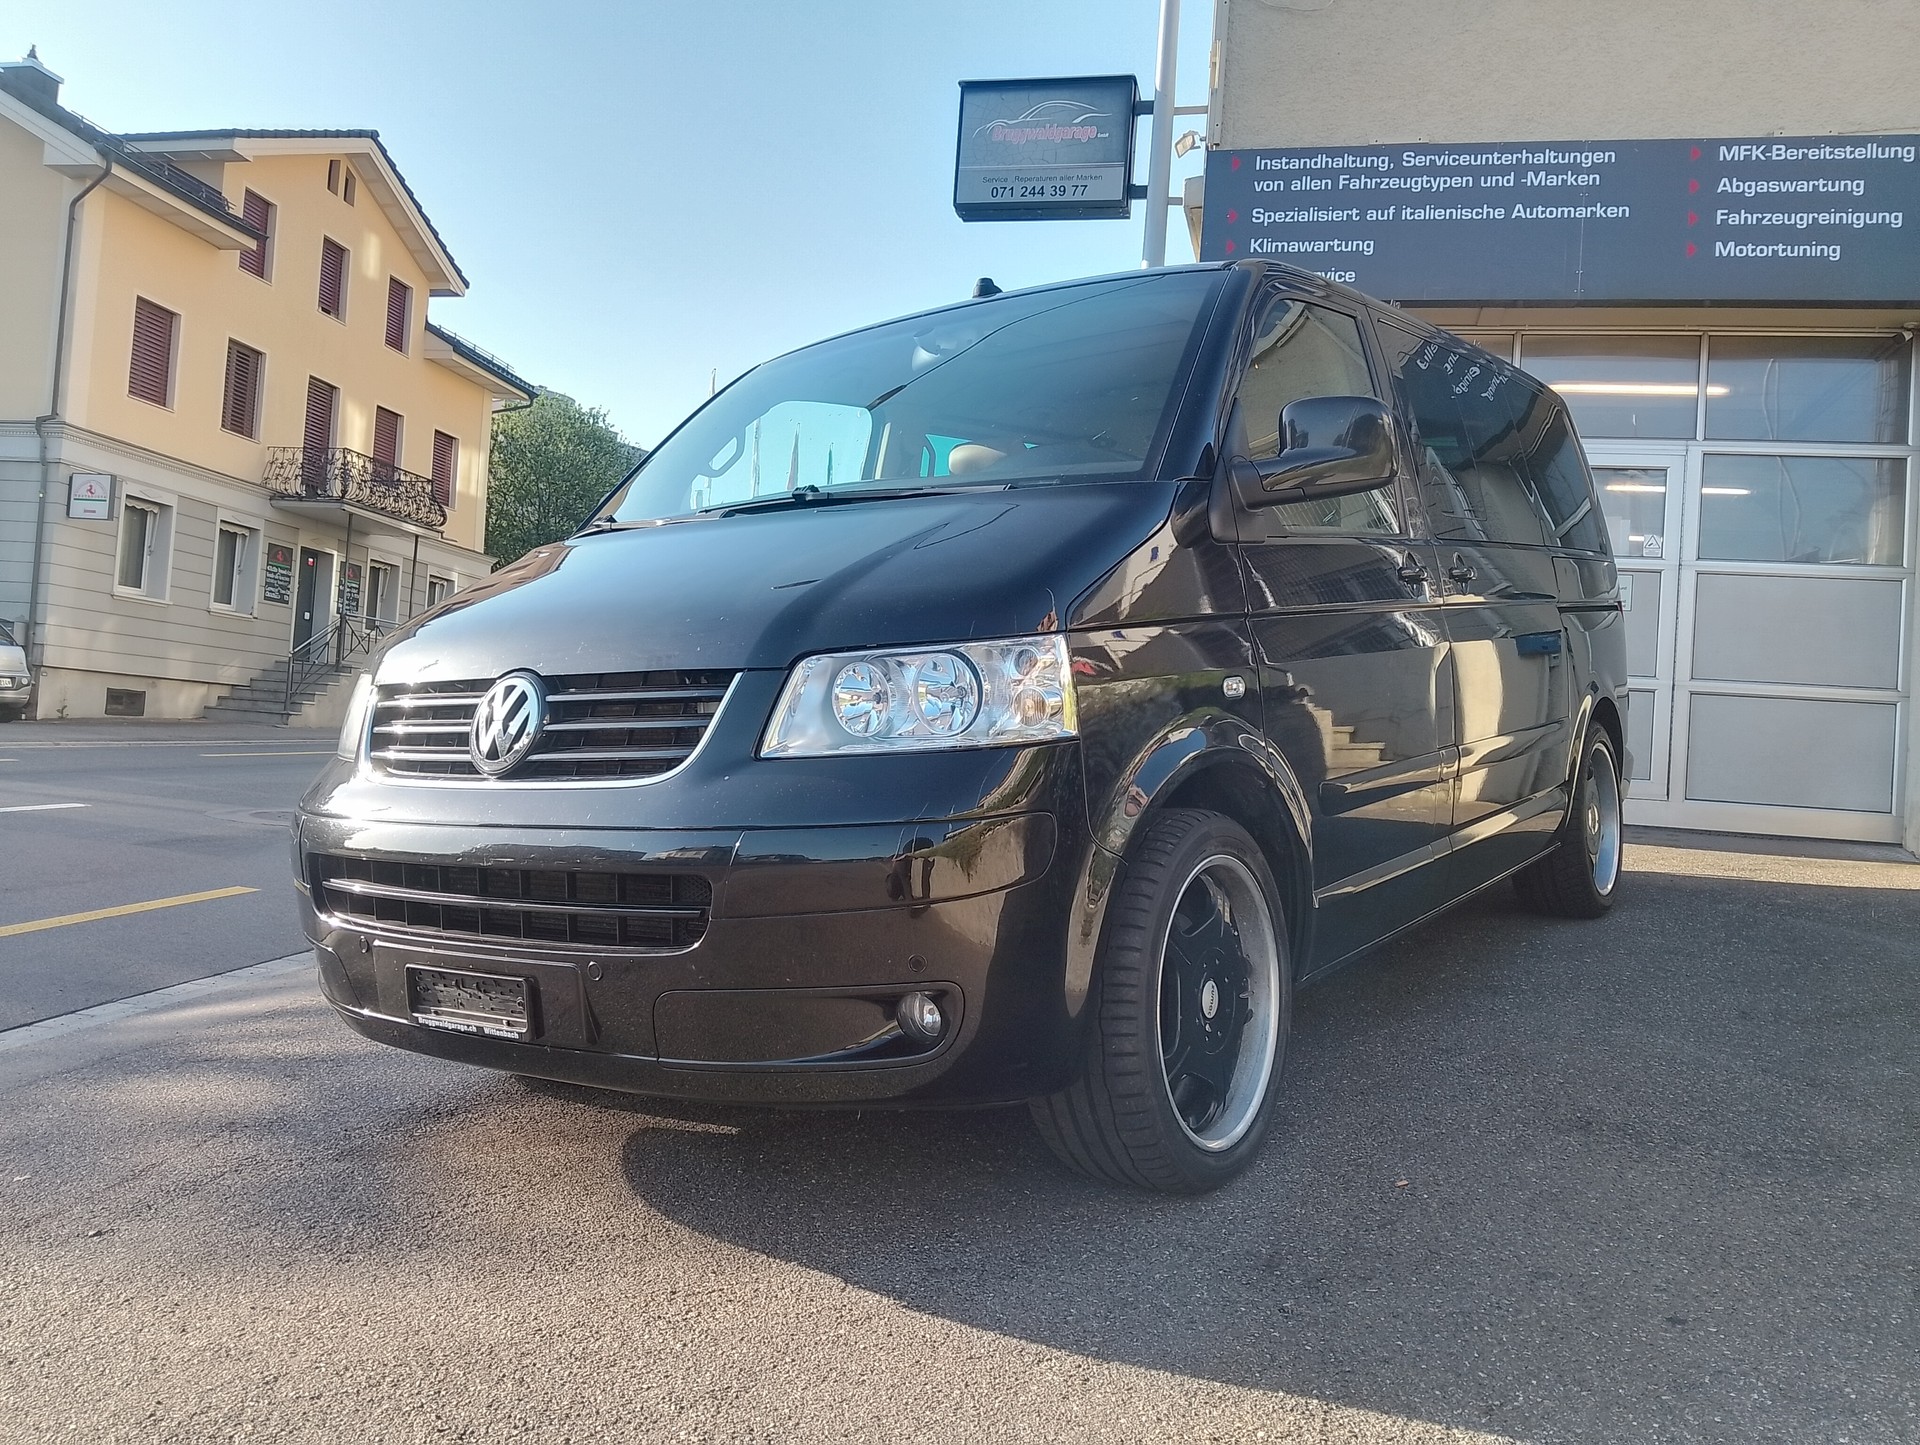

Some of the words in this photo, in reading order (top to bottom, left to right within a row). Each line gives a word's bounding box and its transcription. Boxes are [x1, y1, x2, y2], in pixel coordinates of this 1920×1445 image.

[992, 123, 1097, 144] Bruggwaldgarage
[1255, 153, 1394, 171] Instandhaltung,
[1402, 149, 1616, 167] Serviceunterhaltungen
[1718, 143, 1915, 162] MFK-Bereitstellung
[982, 176, 1009, 184] Service
[1059, 174, 1075, 182] aller
[1254, 180, 1284, 192] von
[1290, 176, 1332, 191] allen
[1338, 174, 1473, 192] Fahrzeugtypen
[1480, 171, 1515, 187] und
[1521, 170, 1600, 187] -Marken
[1716, 177, 1865, 197] Abgaswartung
[990, 186, 1014, 199] 071
[1020, 185, 1046, 198] 244
[1050, 184, 1067, 197] 39
[1071, 184, 1088, 197] 77
[1251, 207, 1360, 226] Spezialisiert
[1366, 205, 1396, 221] auf
[1401, 203, 1506, 221] italienische
[1511, 202, 1630, 219] Automarken
[1715, 209, 1903, 229] Fahrzeugreinigung
[1250, 238, 1375, 256] Klimawartung
[1714, 241, 1841, 261] Motortuning
[483, 1026, 519, 1039] Wittenbach
